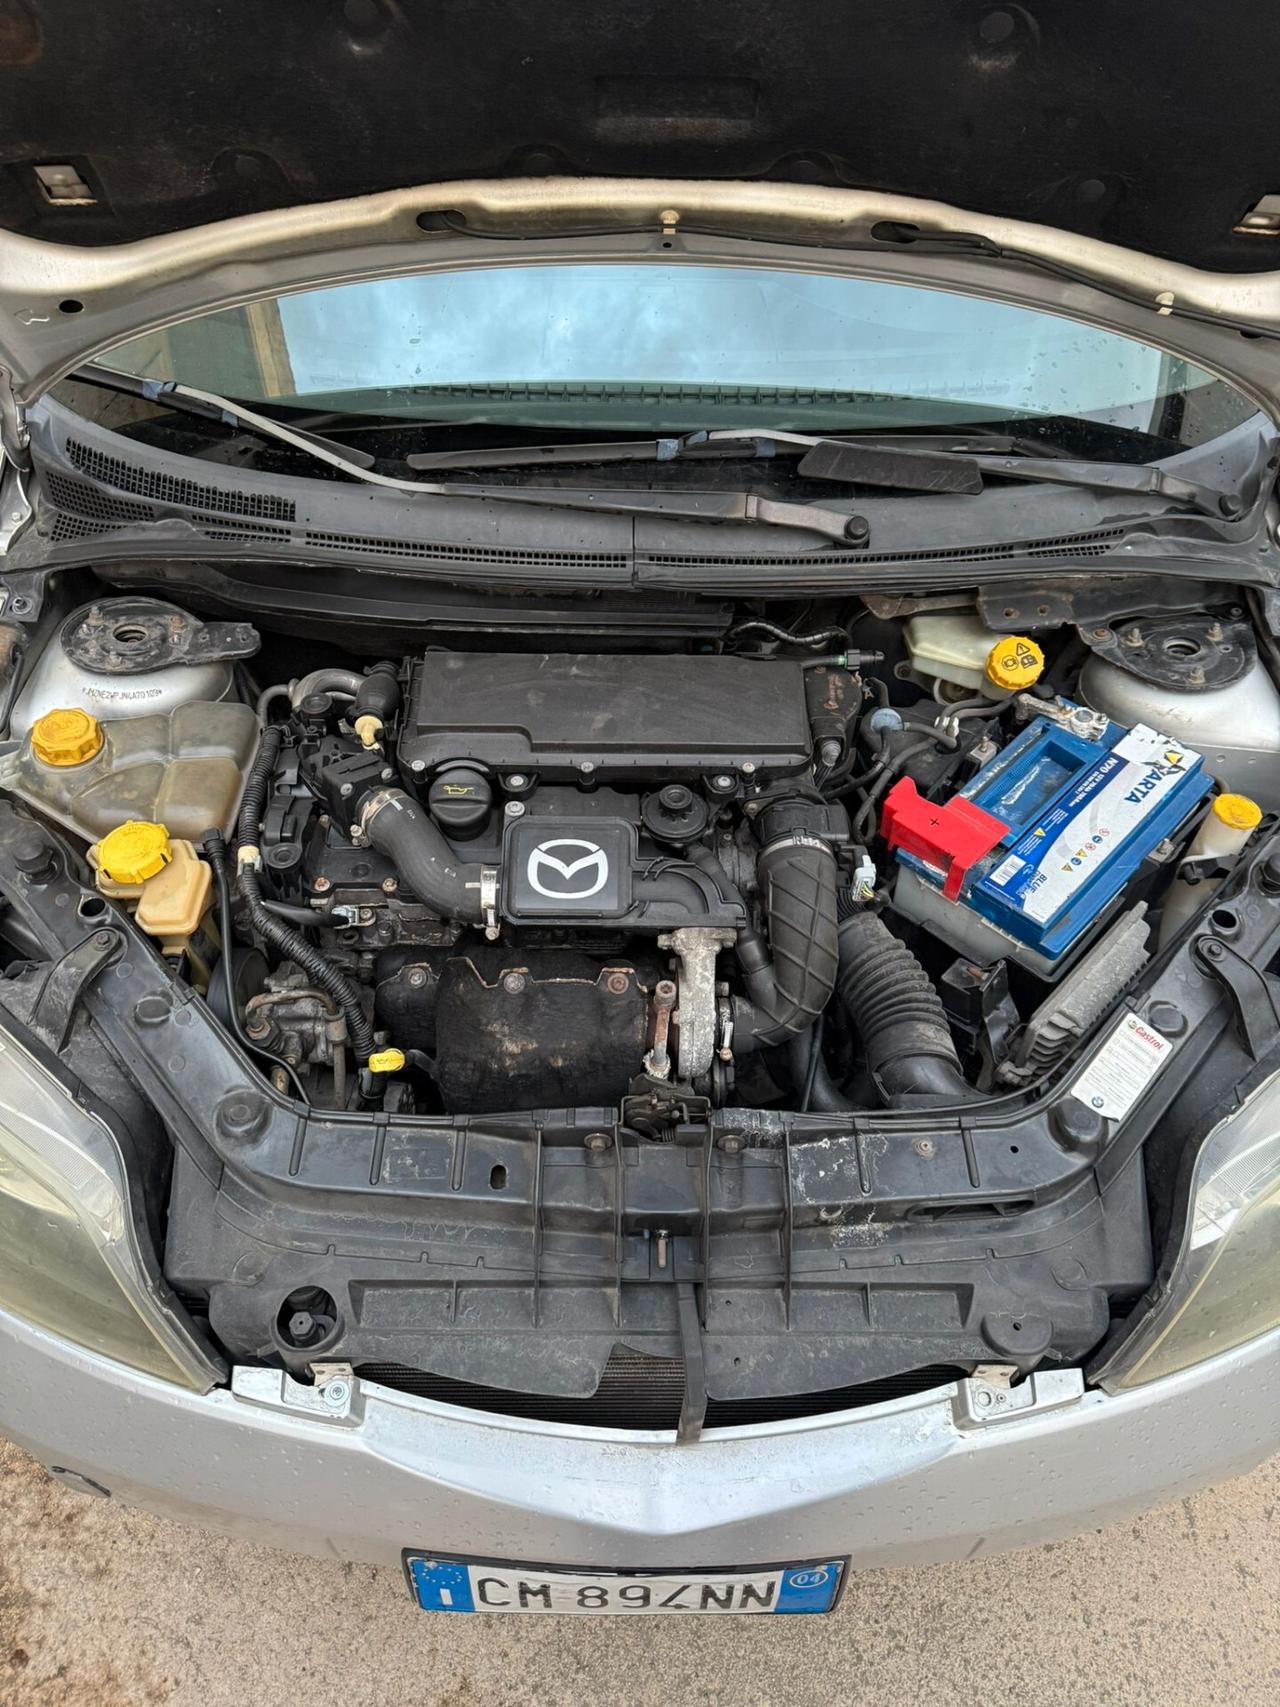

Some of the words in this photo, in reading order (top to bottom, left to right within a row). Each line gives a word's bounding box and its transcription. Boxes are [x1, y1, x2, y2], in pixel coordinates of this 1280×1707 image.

[1099, 757, 1119, 774] N70
[1124, 762, 1170, 804] ARTA
[1030, 873, 1048, 893] BLUE
[1135, 1026, 1165, 1050] Castrol
[796, 1573, 821, 1583] 04
[477, 1577, 552, 1608] CM
